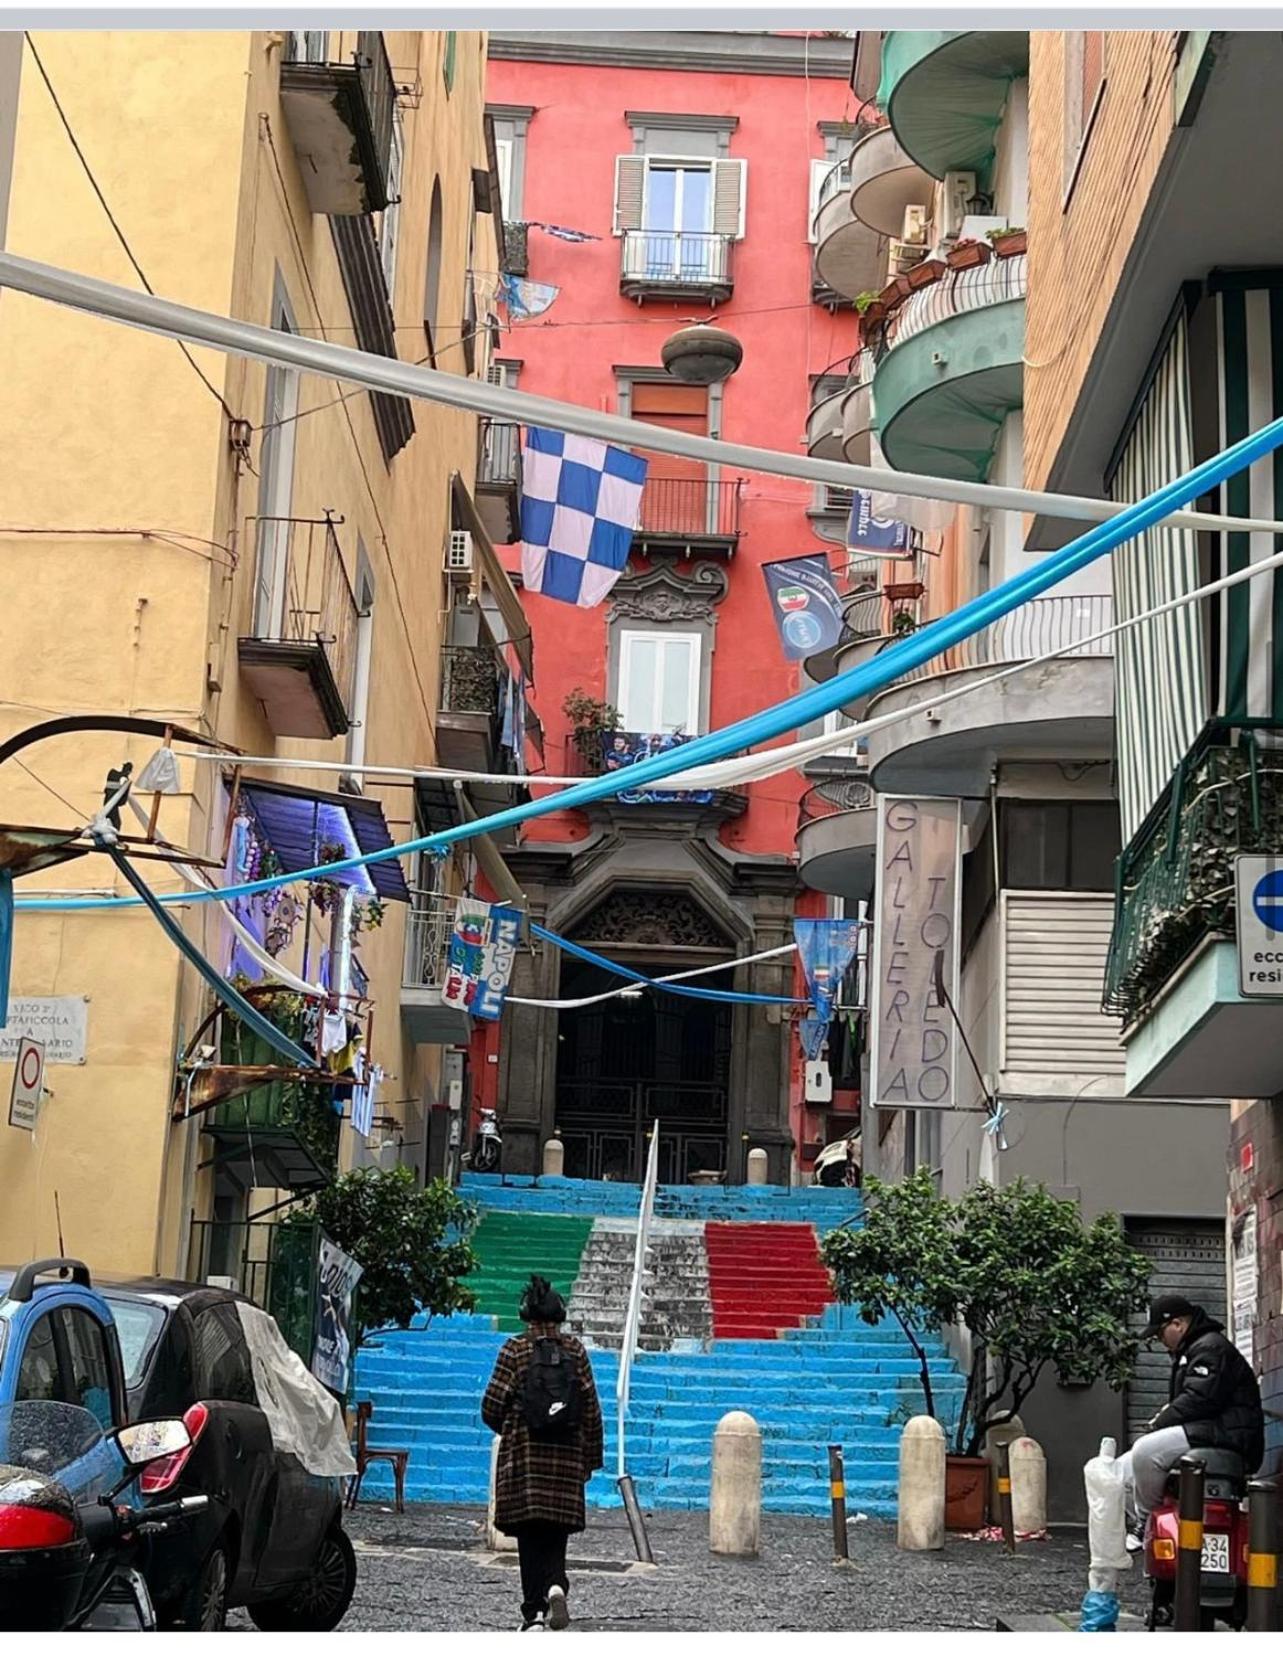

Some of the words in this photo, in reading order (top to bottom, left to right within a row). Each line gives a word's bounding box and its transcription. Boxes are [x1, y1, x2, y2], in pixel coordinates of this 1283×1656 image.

[481, 920, 518, 1013] NAPOLI
[882, 802, 918, 1100] GALLERIA
[27, 1027, 34, 1036] A
[1200, 1553, 1227, 1569] 250
